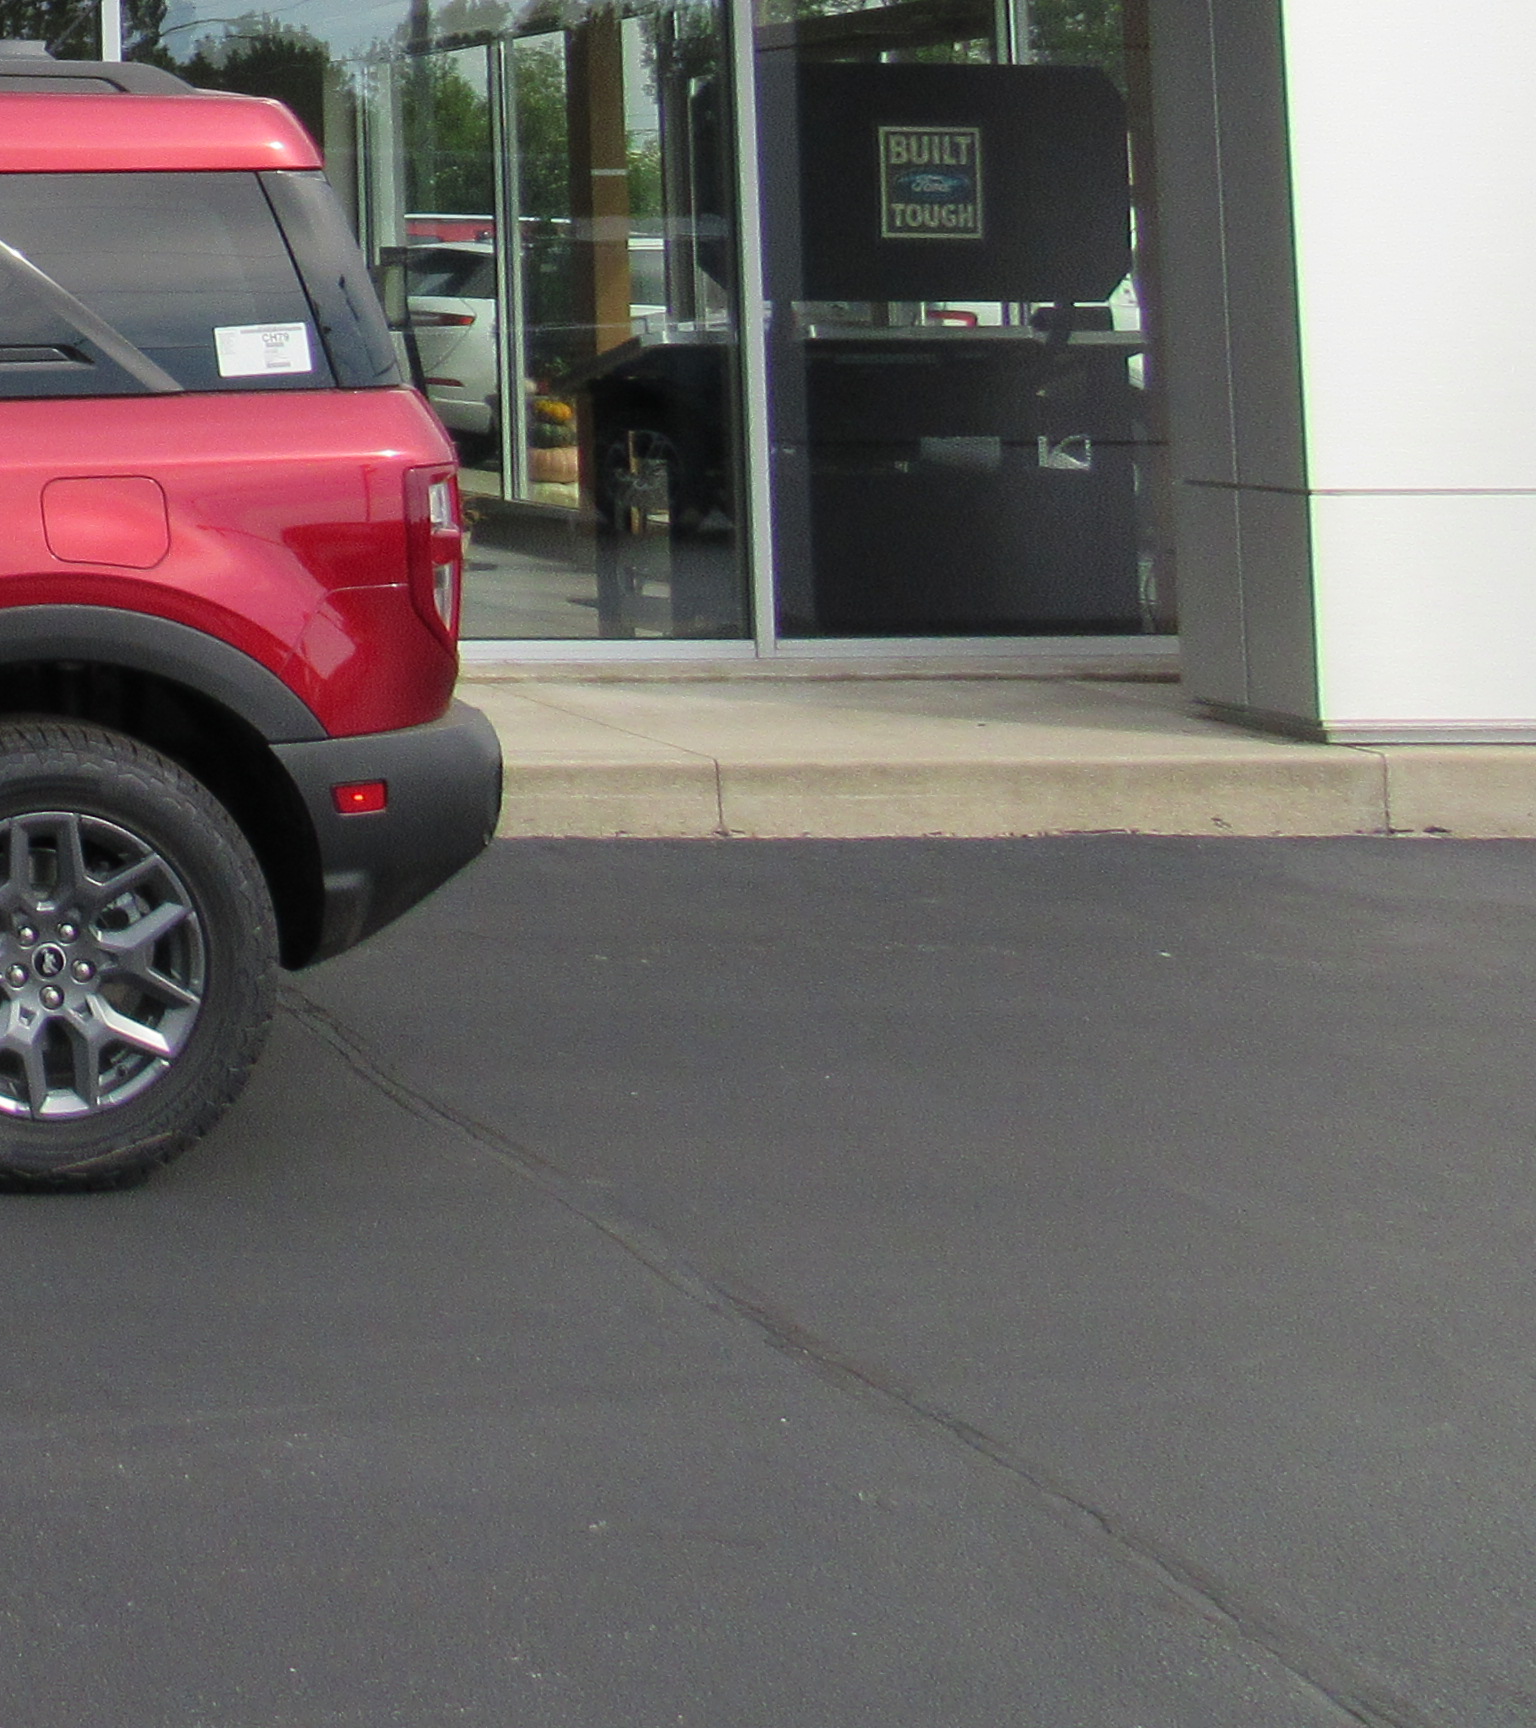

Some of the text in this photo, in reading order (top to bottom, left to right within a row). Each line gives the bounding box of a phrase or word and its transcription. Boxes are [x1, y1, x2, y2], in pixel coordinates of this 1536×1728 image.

[889, 134, 972, 165] BUILT
[890, 203, 975, 228] TOUGH
[262, 333, 290, 343] CH79
